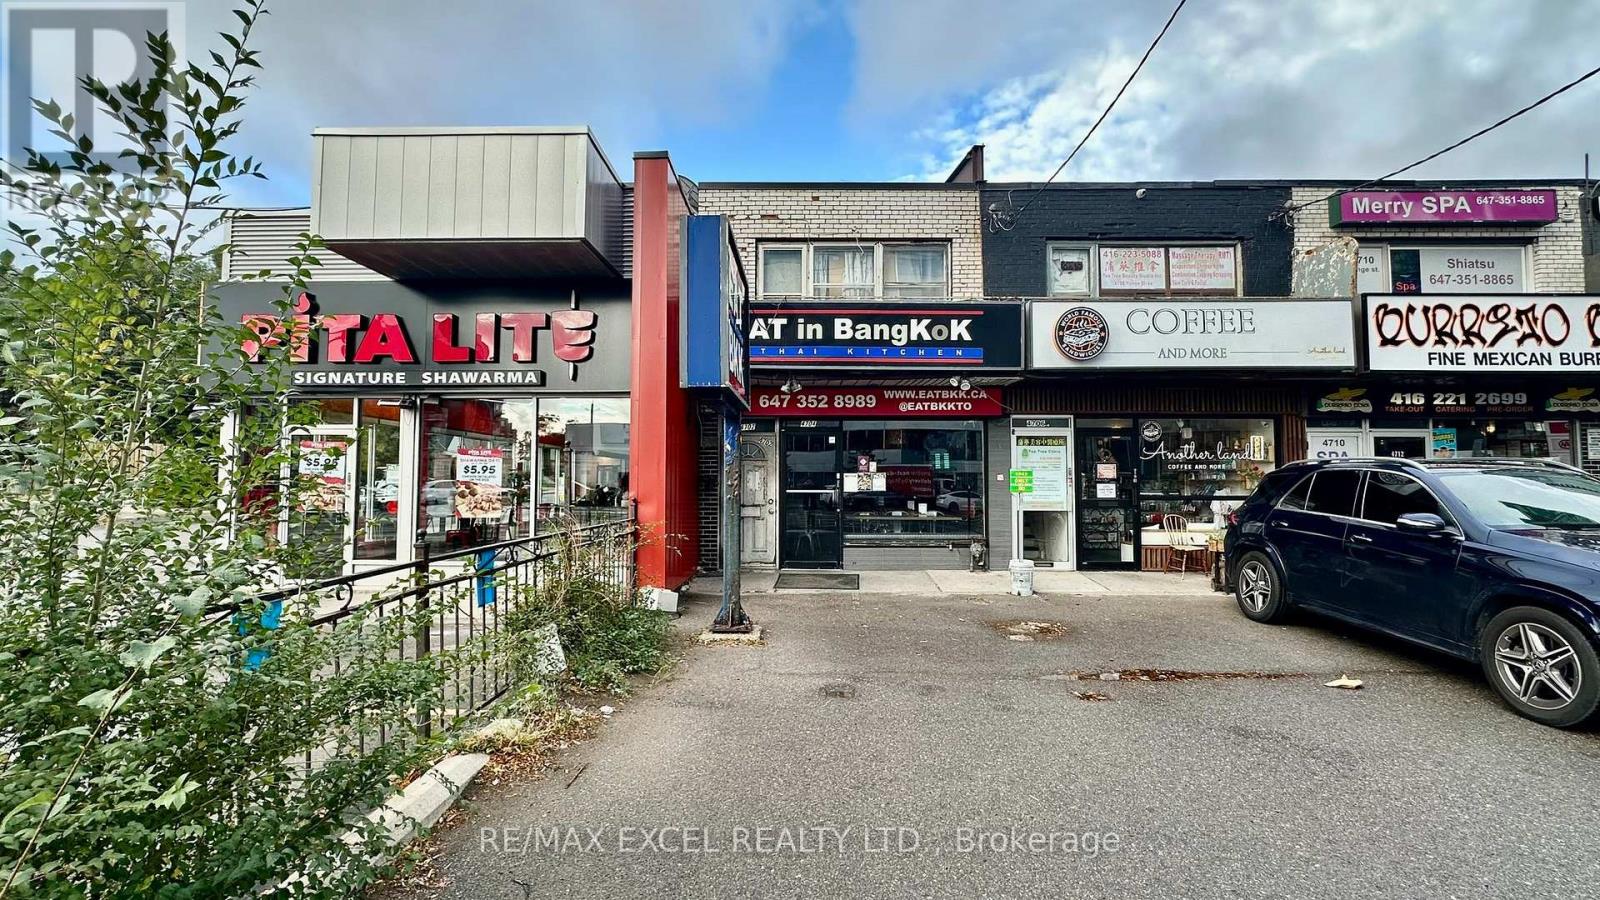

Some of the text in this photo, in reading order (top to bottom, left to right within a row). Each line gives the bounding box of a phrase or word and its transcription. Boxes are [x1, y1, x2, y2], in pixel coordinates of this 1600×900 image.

[1352, 195, 1545, 218] Merry SPA 647-351-8865
[1357, 255, 1375, 264] 710
[1447, 258, 1495, 269] Shiatsu
[1429, 274, 1514, 285] 647-351-8865
[1396, 281, 1416, 292] Spa
[1126, 308, 1255, 334] COFFEE
[750, 318, 973, 346] AT in BangKoK
[760, 347, 963, 356] THAI KITCHEN
[1157, 347, 1227, 359] AND MORE
[1428, 352, 1466, 365] FINE
[1473, 352, 1552, 366] MEXICAN
[293, 371, 538, 384] SIGNATURE SHAWARMA
[884, 389, 987, 399] WWW.EATBKK.CA
[1390, 392, 1527, 405] 416 221 2699
[758, 394, 877, 408] 647 352 8989
[899, 401, 972, 412] @EATBKKTO
[1322, 439, 1346, 447] 4710
[1140, 441, 1215, 460] Another
[1217, 441, 1252, 460] land
[463, 465, 496, 474] $5.95
